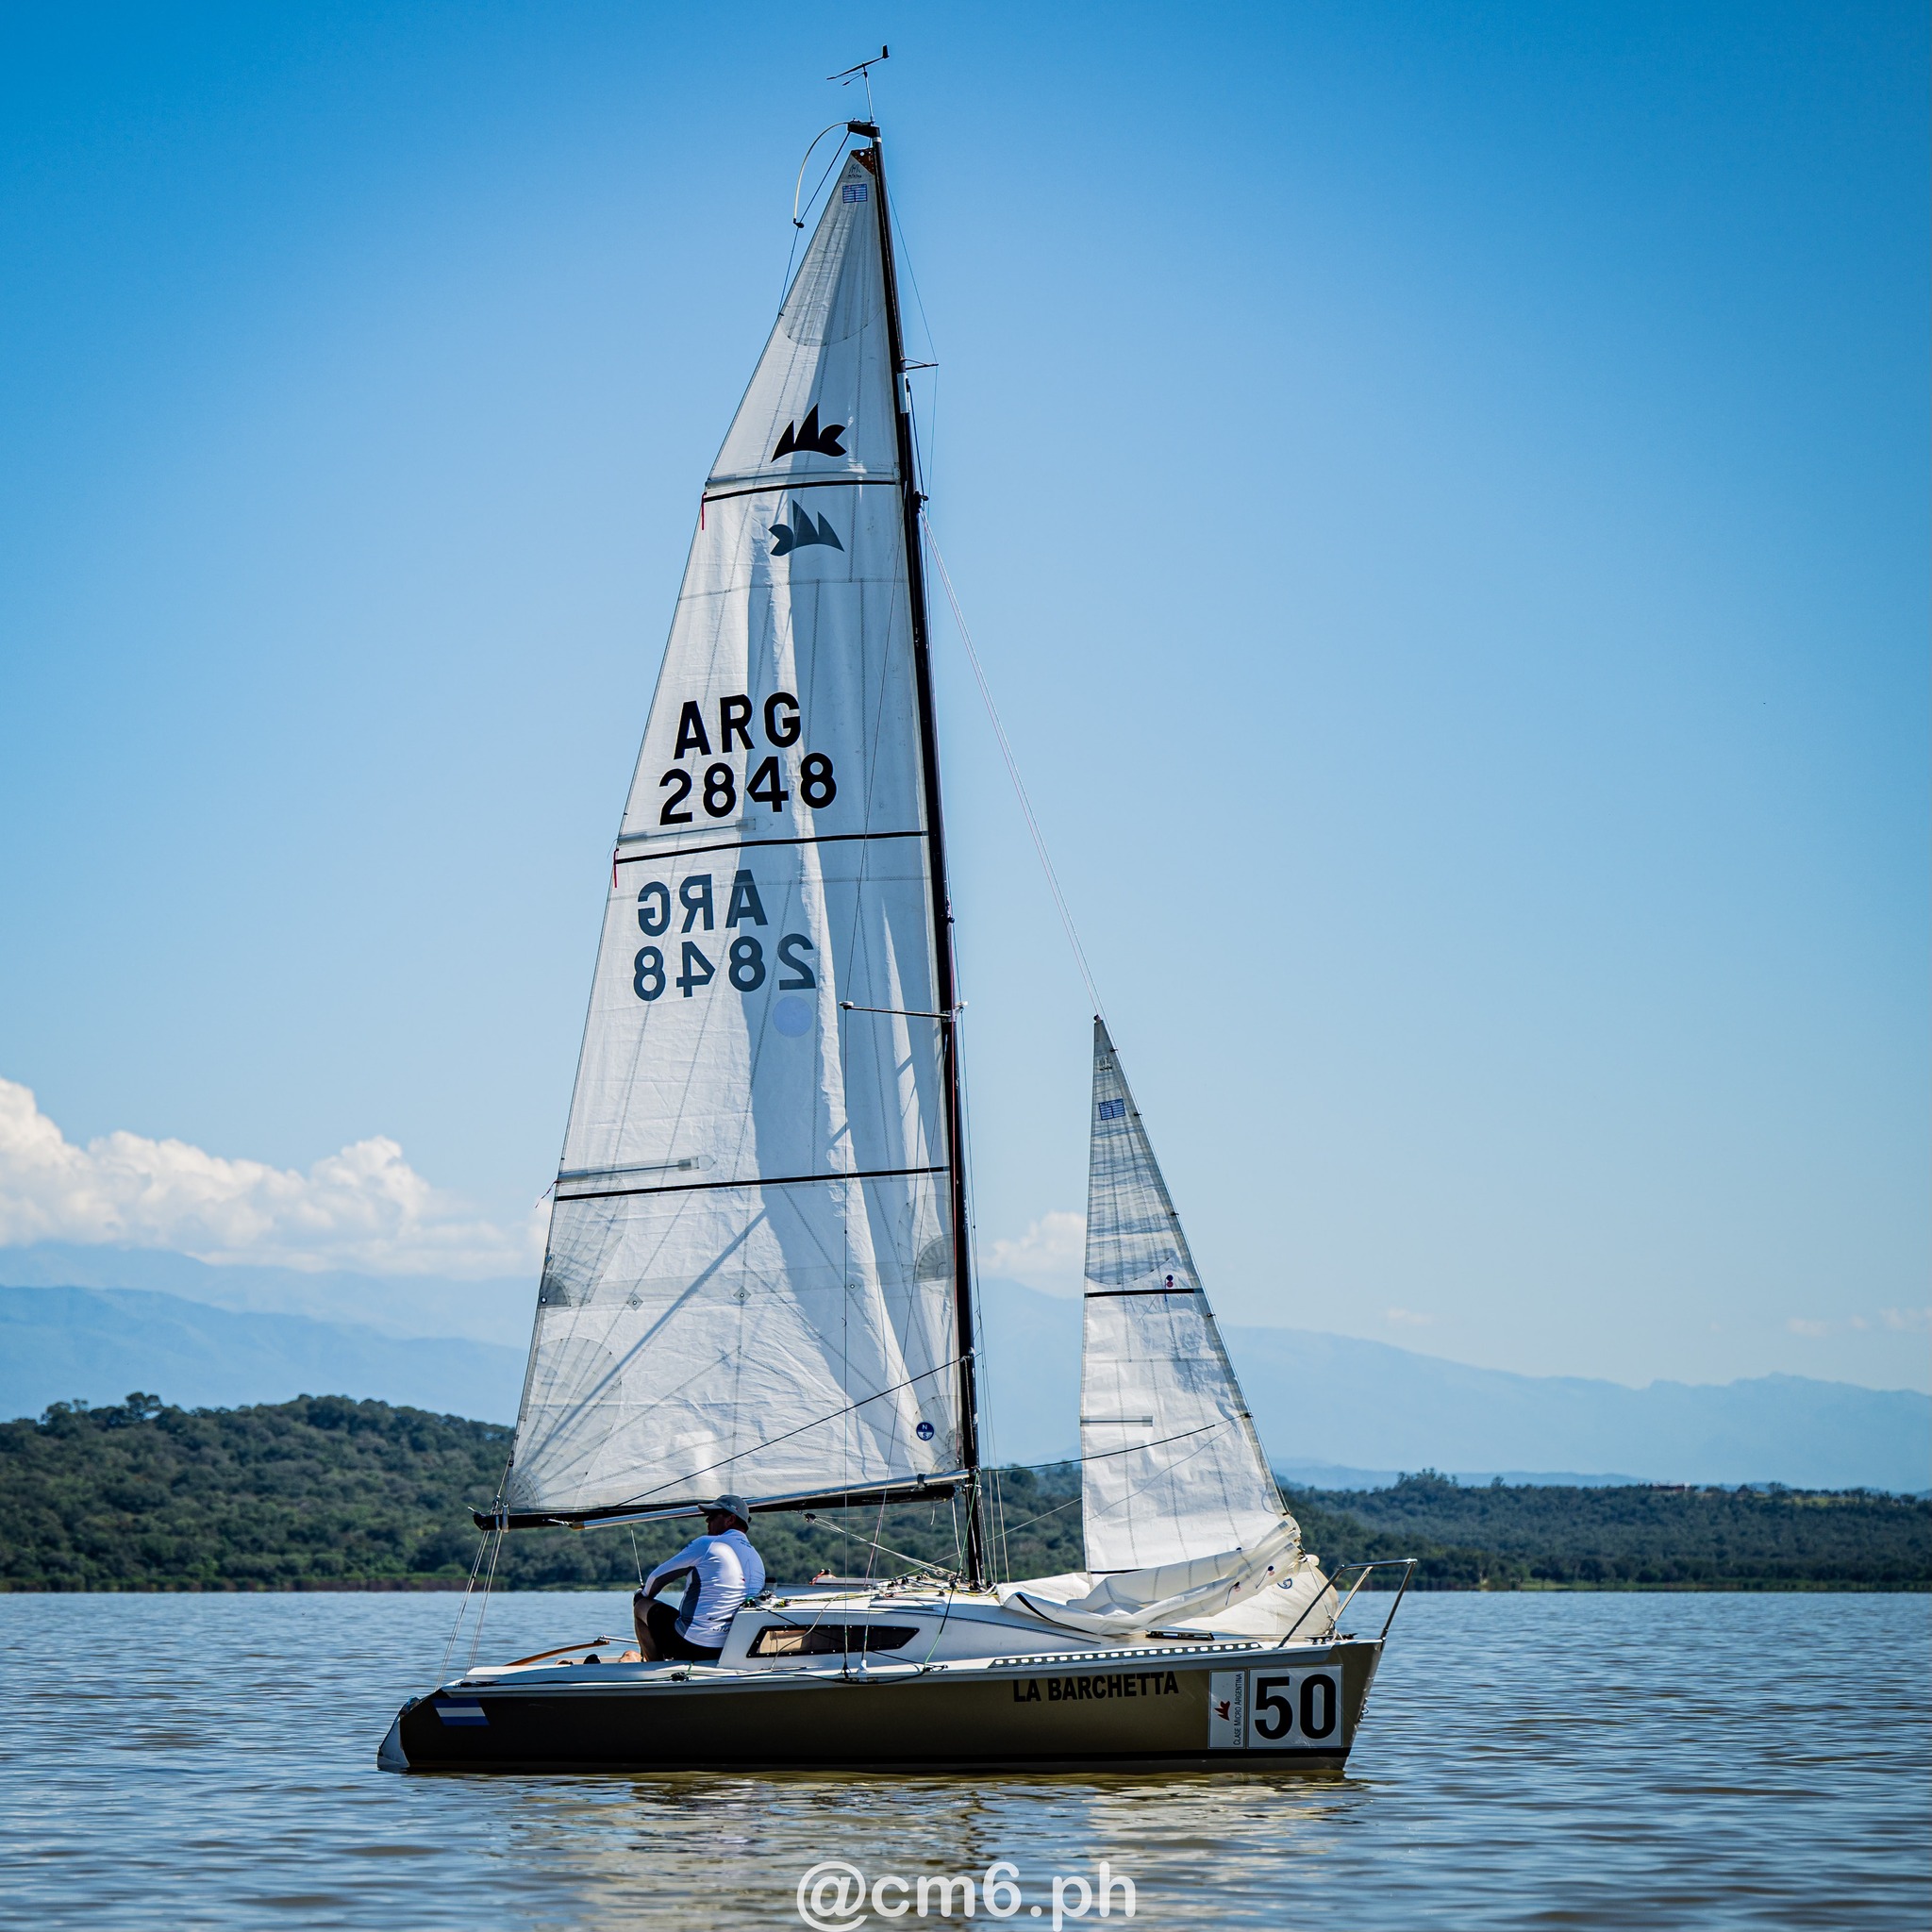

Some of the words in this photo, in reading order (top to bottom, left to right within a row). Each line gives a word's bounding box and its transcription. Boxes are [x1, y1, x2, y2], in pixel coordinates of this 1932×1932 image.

[673, 691, 802, 760] ARG
[658, 752, 838, 826] 2848
[1012, 1678, 1042, 1703] LA
[1047, 1671, 1180, 1702] BARCHETTA
[1234, 1673, 1243, 1707] ARGENTINA
[1233, 1707, 1242, 1726] MICRO
[1254, 1674, 1337, 1740] 50
[1232, 1727, 1242, 1746] CLASE
